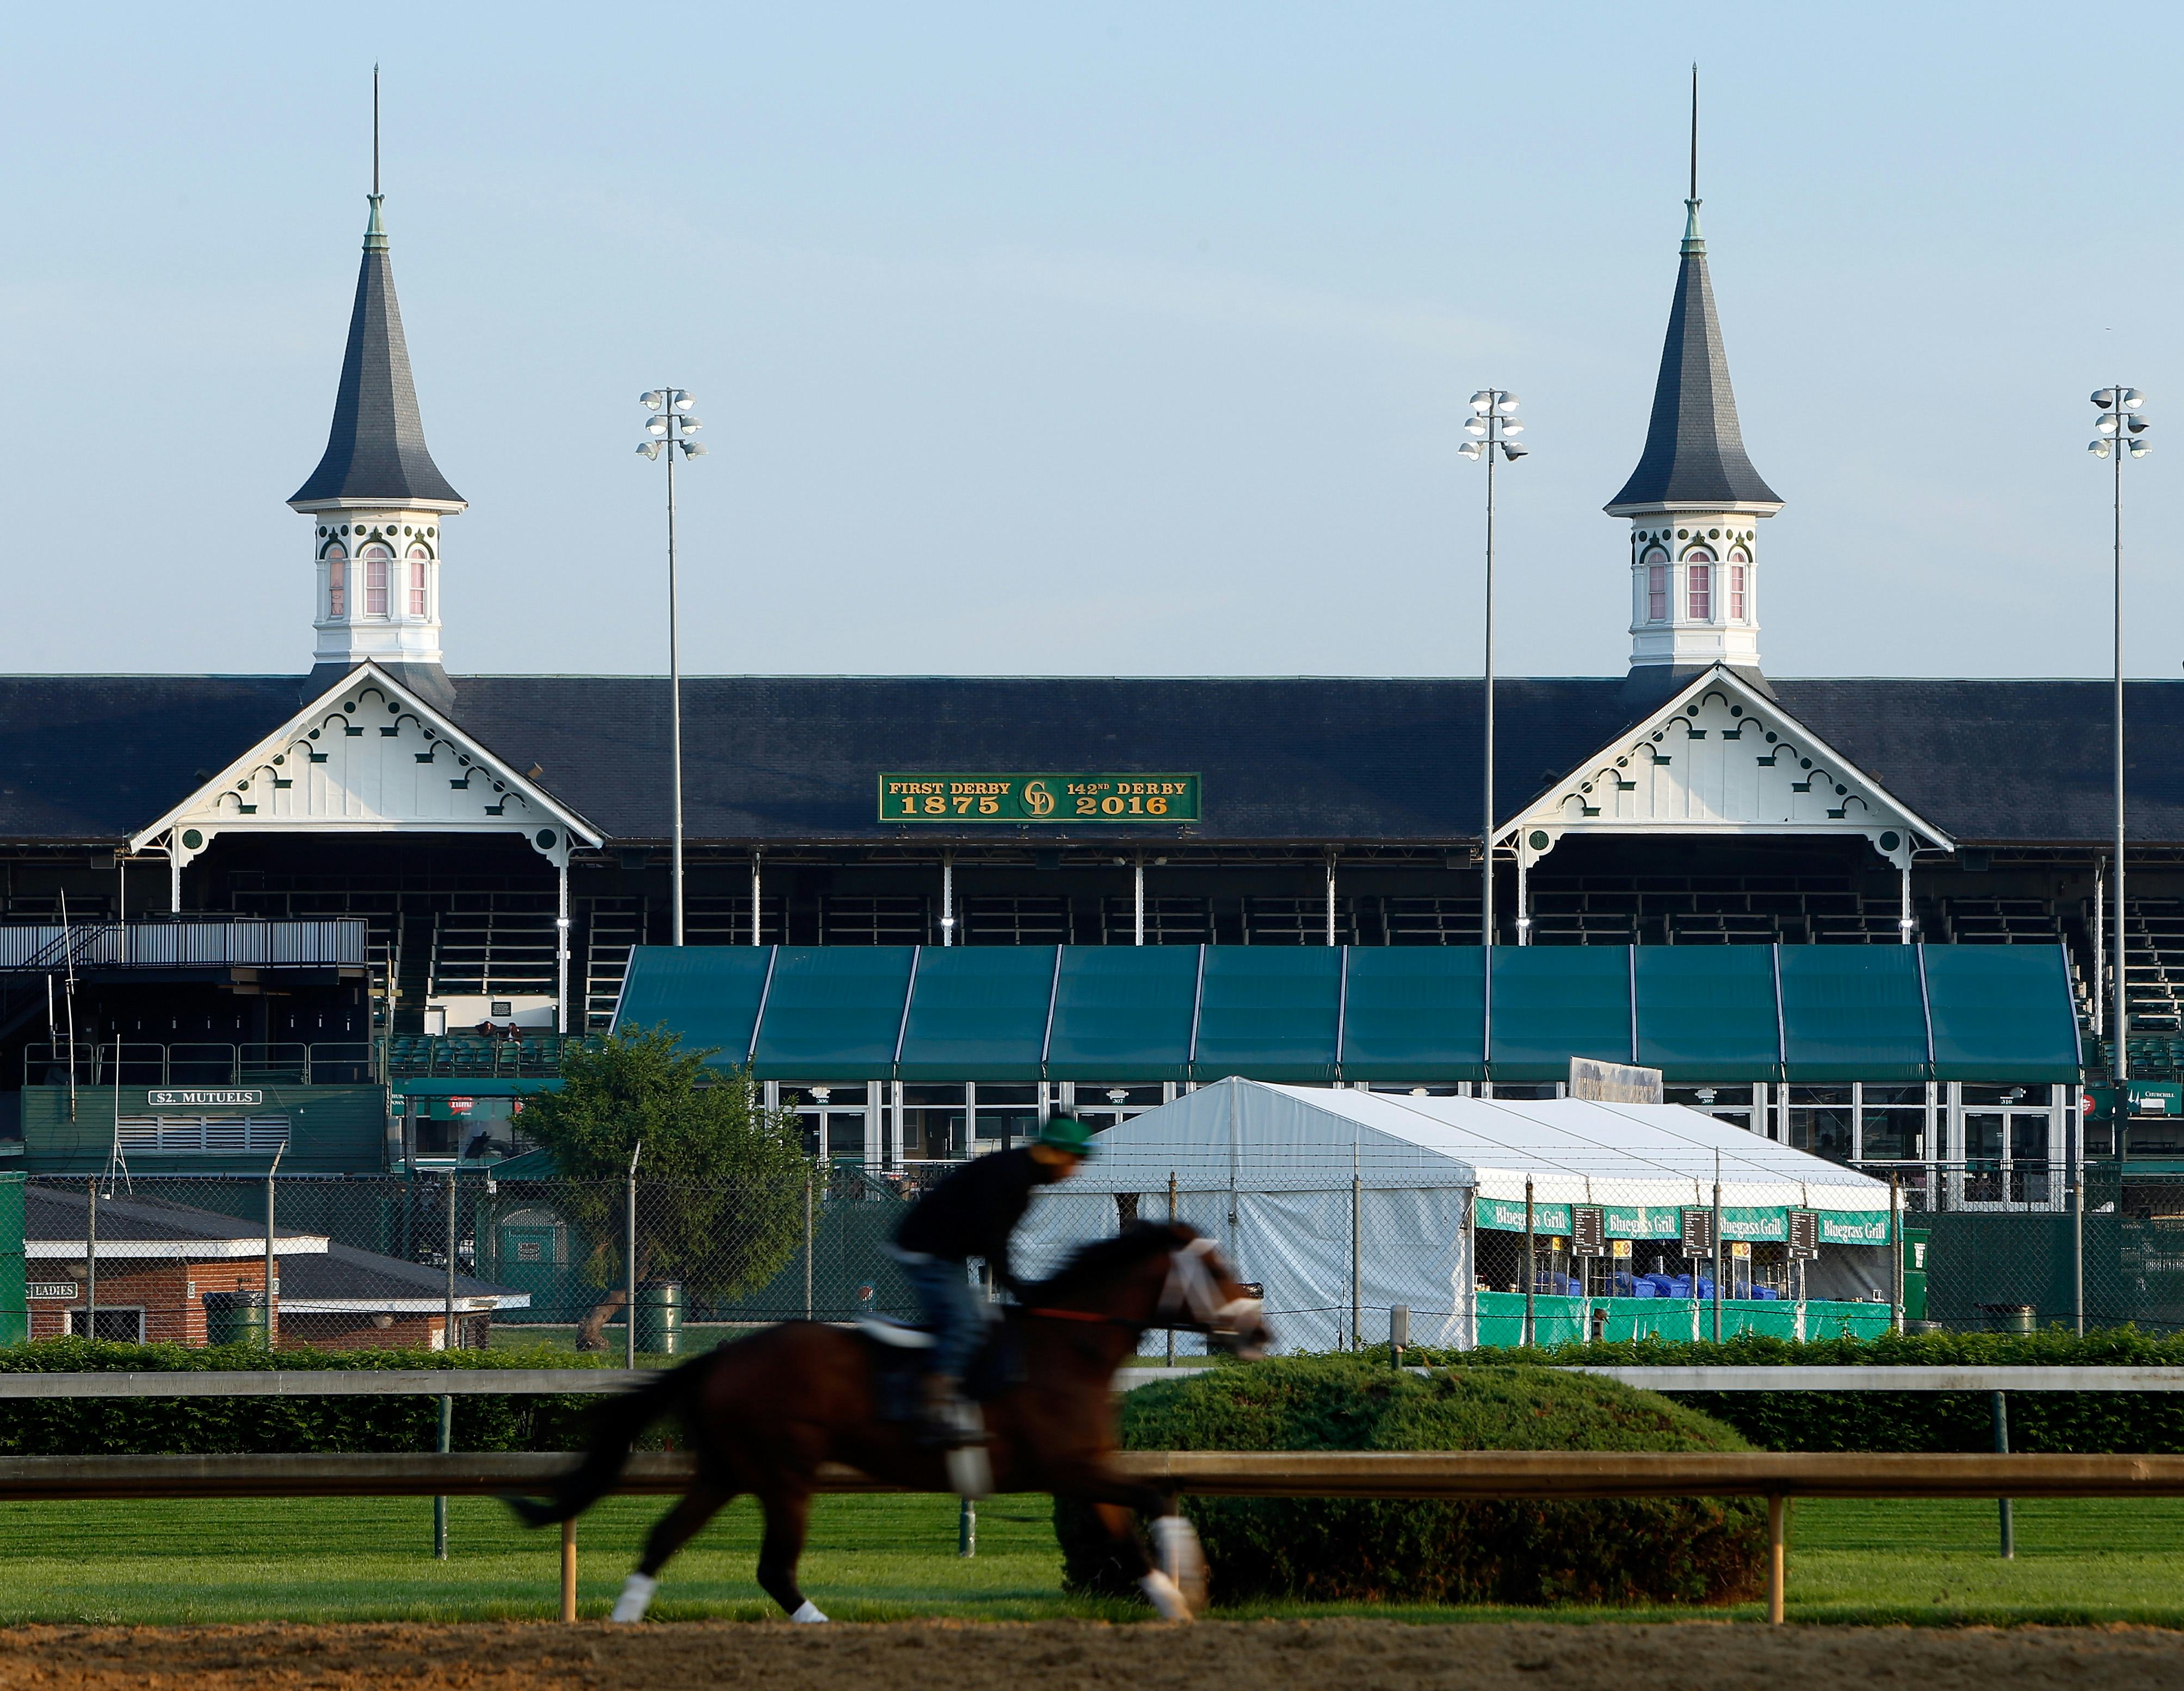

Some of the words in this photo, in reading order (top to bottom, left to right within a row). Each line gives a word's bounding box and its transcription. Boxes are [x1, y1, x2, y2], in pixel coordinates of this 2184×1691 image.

[889, 783, 943, 794] FIRST
[950, 783, 1010, 794] DERBY
[1117, 783, 1186, 794] DERBY
[902, 796, 999, 814] 1875
[1076, 797, 1167, 814] 2016
[157, 1093, 176, 1103] $2.
[182, 1093, 253, 1102] MUTUELS
[1495, 1206, 1540, 1231] Bluegrss
[1544, 1210, 1566, 1229] Grill
[1655, 1215, 1675, 1233] Grill
[1761, 1218, 1782, 1235] Grill
[1823, 1220, 1864, 1242] Bluegrass
[1865, 1222, 1885, 1239] Grill
[35, 1285, 73, 1295] LADIES
